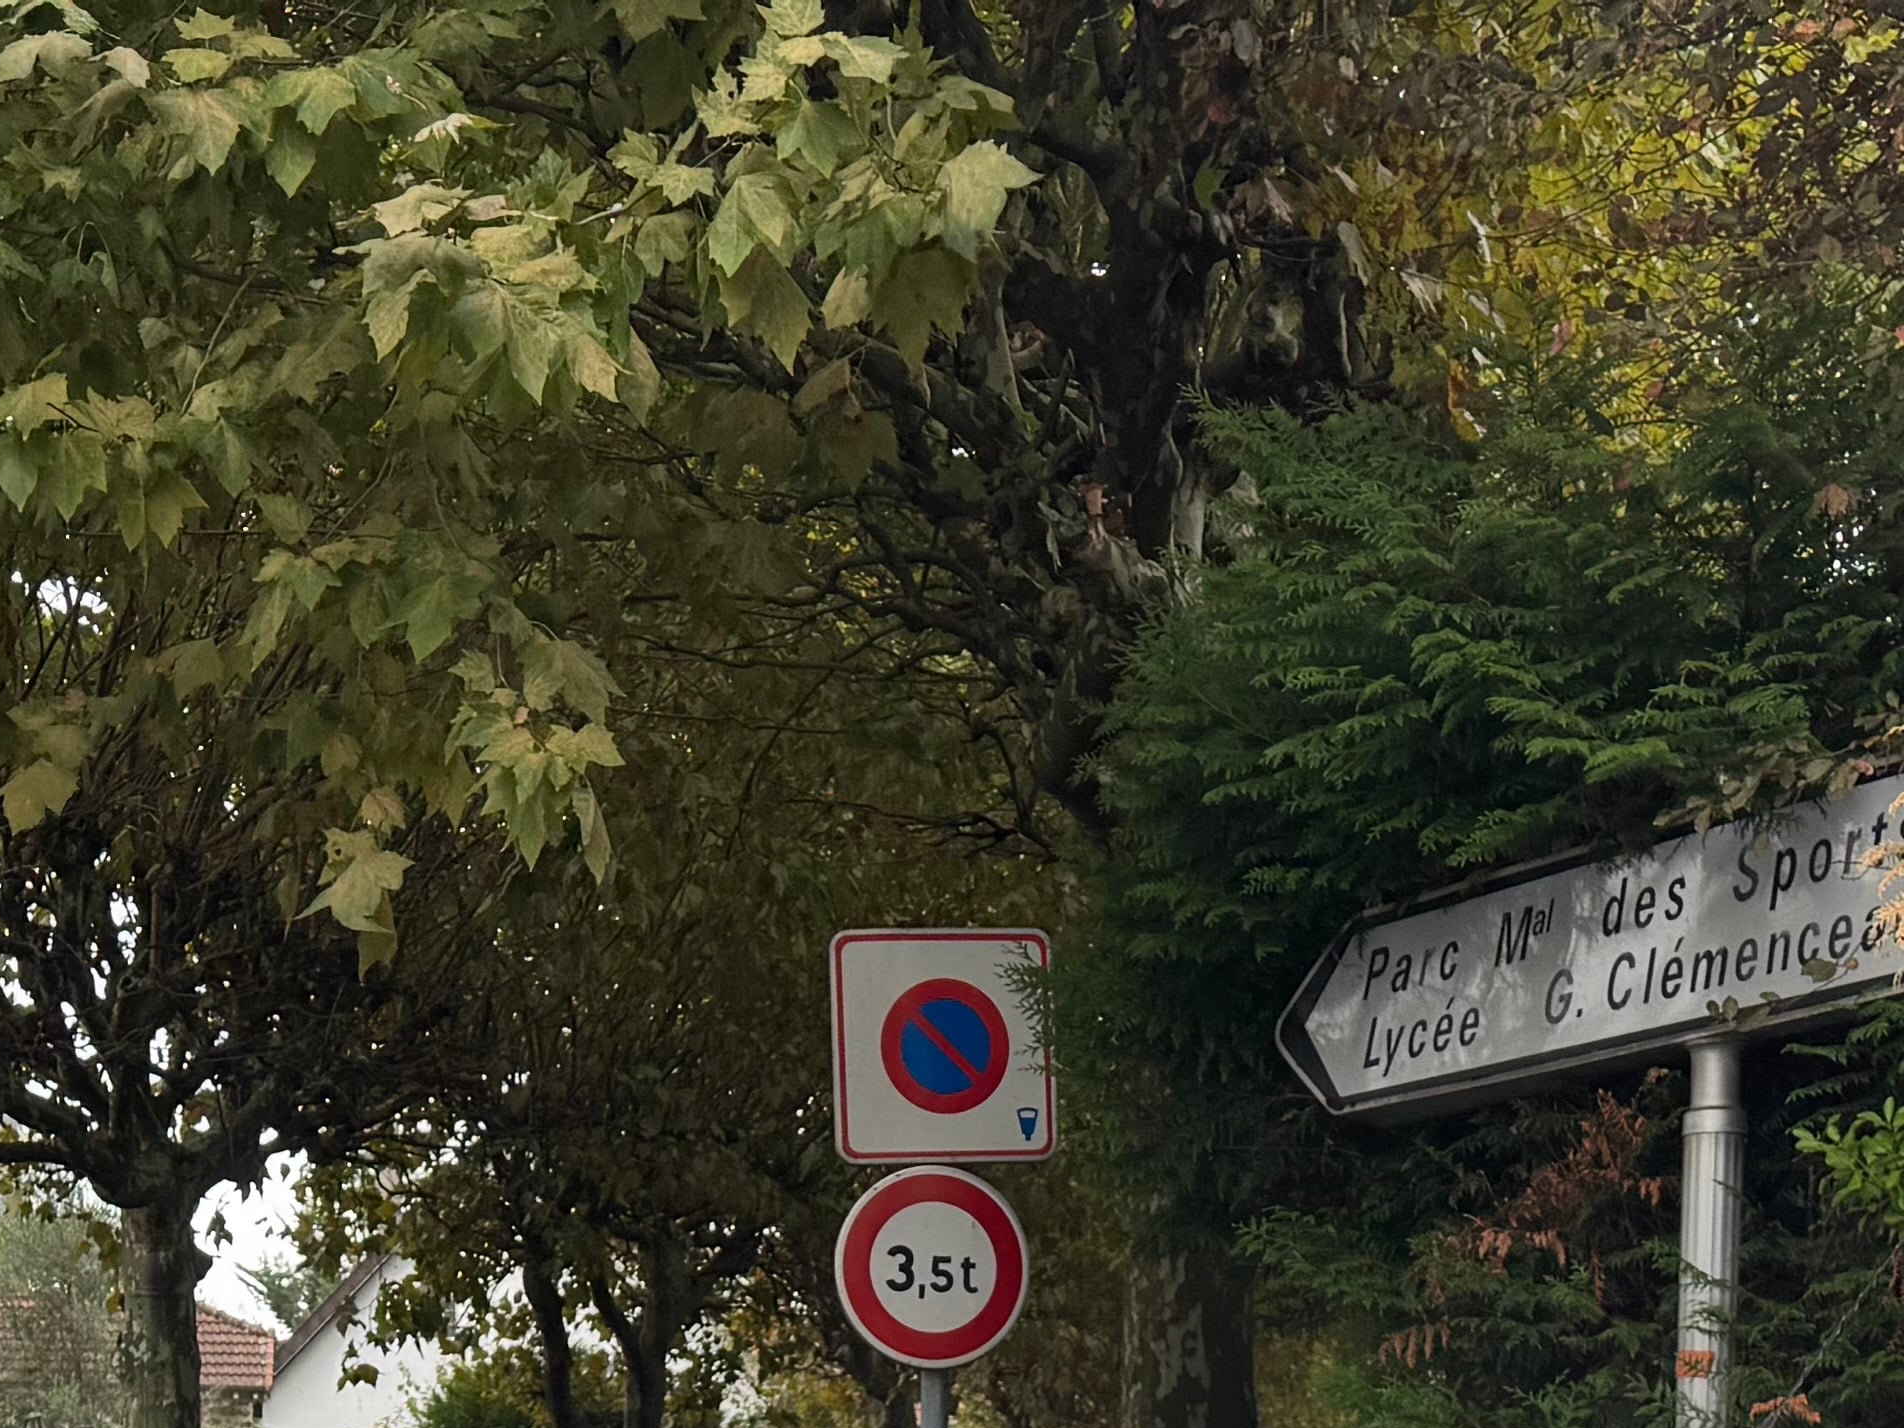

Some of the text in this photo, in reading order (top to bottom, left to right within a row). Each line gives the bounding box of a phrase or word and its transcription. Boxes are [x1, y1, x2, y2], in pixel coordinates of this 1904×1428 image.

[1364, 931, 1459, 1000] Parc
[1496, 897, 1556, 970] Mal
[1602, 873, 1686, 938] des
[1363, 997, 1481, 1077] Lycée
[1544, 968, 1584, 1026] G.
